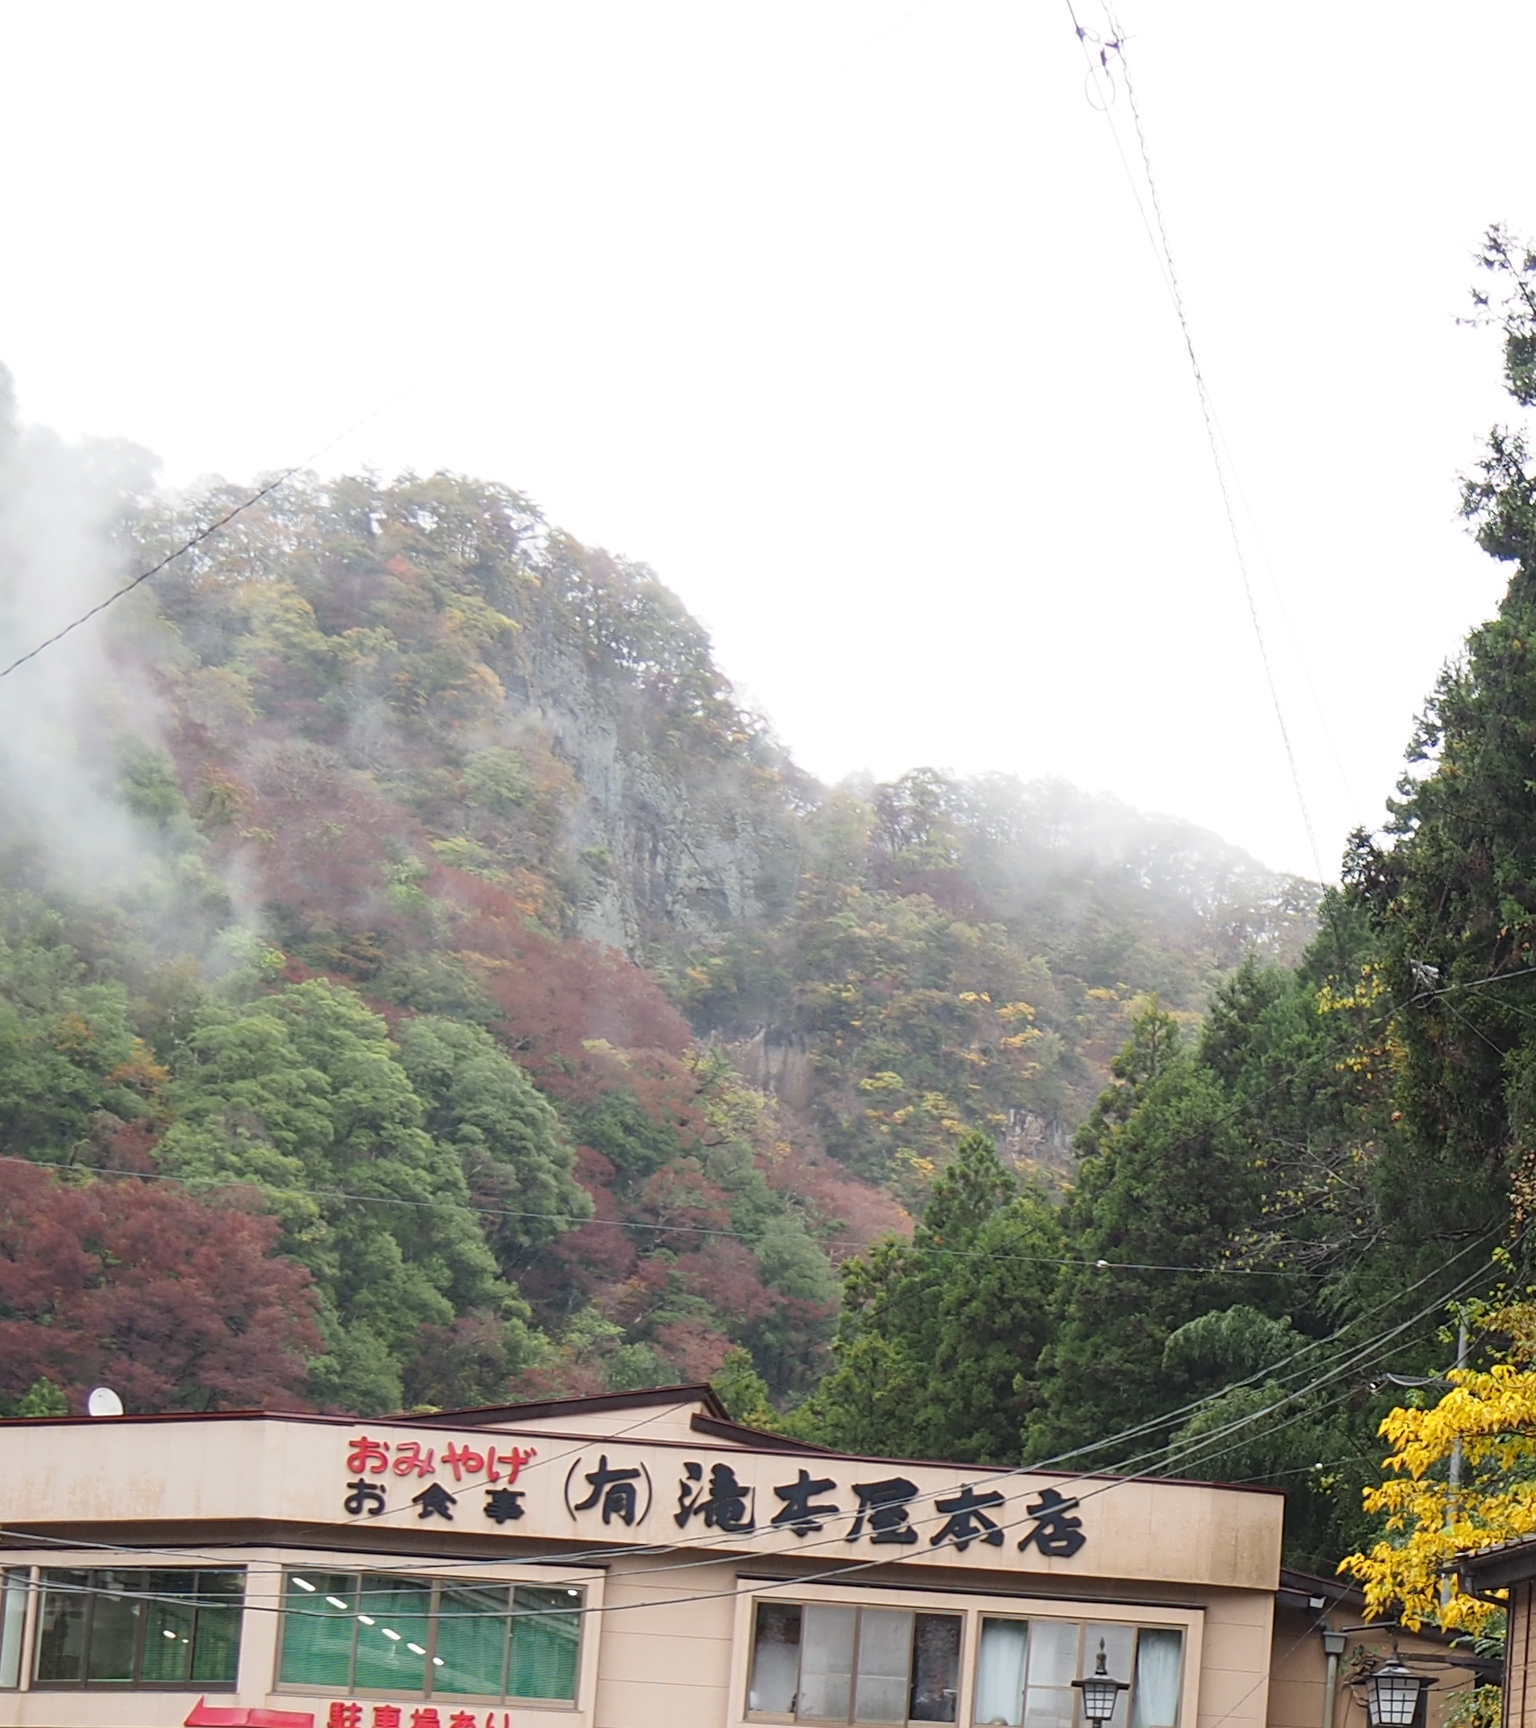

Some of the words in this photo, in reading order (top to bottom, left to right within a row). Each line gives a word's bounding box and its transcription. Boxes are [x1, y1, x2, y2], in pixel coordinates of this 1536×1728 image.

[347, 1436, 538, 1484] おみやげ
[343, 1478, 526, 1524] お食事
